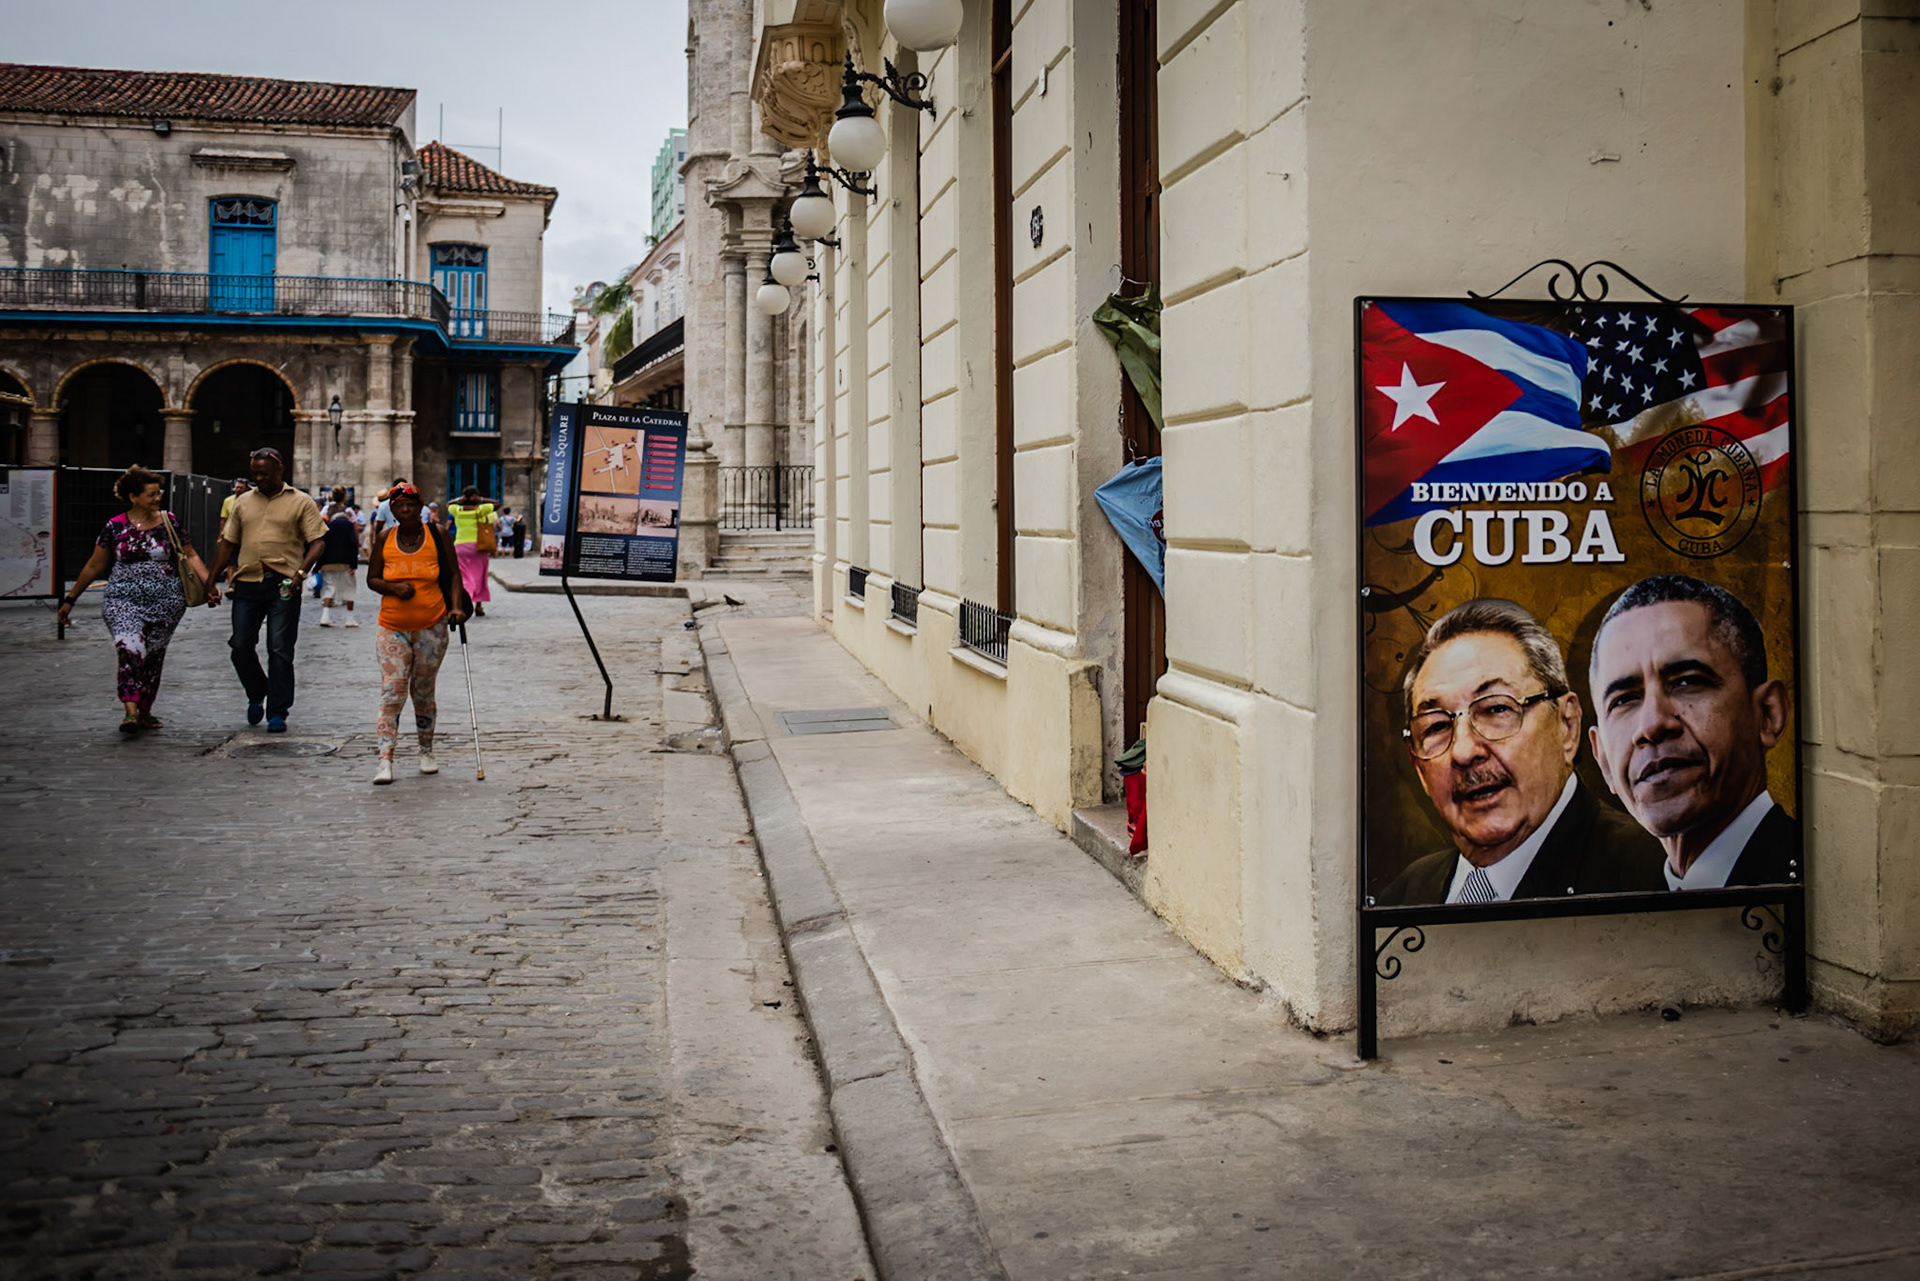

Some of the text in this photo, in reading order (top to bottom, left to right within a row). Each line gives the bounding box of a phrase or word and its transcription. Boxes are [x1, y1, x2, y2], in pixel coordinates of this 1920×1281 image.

[549, 415, 569, 524] CATHEDRAL SQUARE
[1645, 430, 1757, 493] LA MONEDA CUBANA
[1410, 481, 1614, 502] BIENVENIDO A
[1412, 509, 1626, 566] CUBA
[1678, 538, 1724, 554] CUBA
